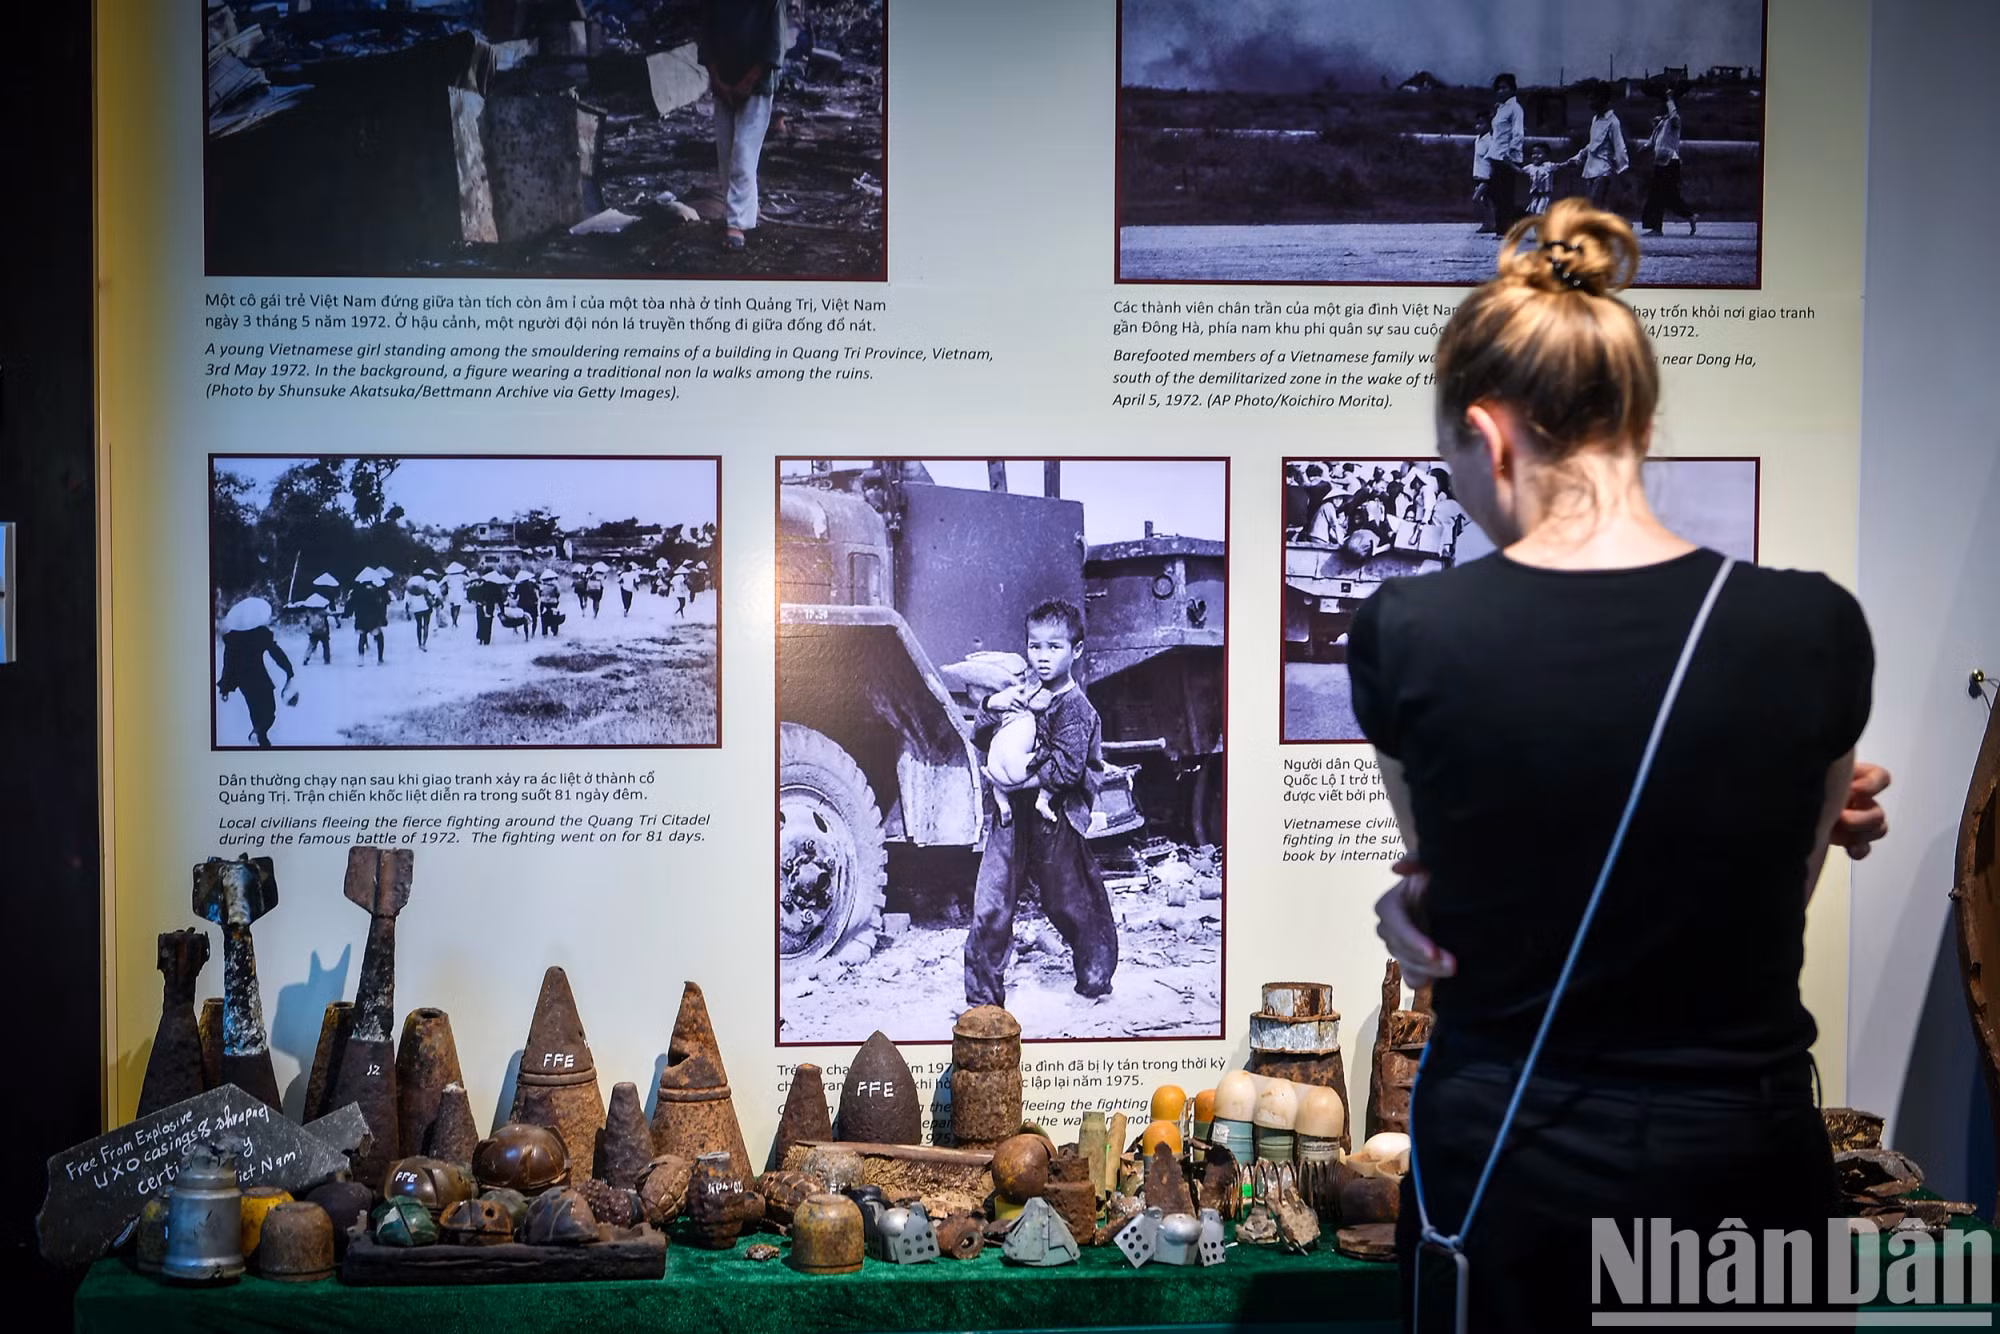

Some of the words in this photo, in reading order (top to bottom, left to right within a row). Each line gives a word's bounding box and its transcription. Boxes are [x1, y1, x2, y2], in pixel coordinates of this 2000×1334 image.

[1633, 305, 1656, 320] hạy
[1660, 304, 1687, 317] trốn
[1692, 305, 1719, 318] khỏi
[1724, 306, 1744, 318] nơi
[1749, 307, 1776, 320] giao
[1780, 306, 1814, 318] tranh
[205, 343, 215, 355] A
[220, 346, 264, 358] young
[270, 343, 353, 356] Vietnamese
[357, 343, 380, 359] girl
[384, 344, 446, 359] standing
[450, 348, 500, 359] among
[505, 344, 527, 356] the
[532, 344, 619, 360] smouldering
[624, 346, 680, 358] remains
[684, 346, 700, 360] of
[702, 349, 711, 358] a
[716, 346, 771, 361] building
[776, 346, 788, 358] in
[793, 347, 839, 361] Quang
[844, 347, 861, 359] Tri
[865, 347, 926, 361] Province,
[933, 348, 992, 362] Vietnam,
[1114, 349, 1190, 364] Barefooted
[1193, 350, 1256, 362] members
[1260, 350, 1275, 365] of
[1278, 353, 1286, 362] a
[1291, 350, 1368, 362] Vietnamese
[1371, 350, 1414, 366] family
[1662, 355, 1693, 365] near
[1696, 354, 1731, 367] Dong
[1735, 354, 1756, 367] Ha,
[205, 363, 230, 376] 3rd
[234, 364, 266, 378] May
[271, 364, 309, 376] 1972.
[316, 364, 328, 376] In
[333, 364, 356, 376] the
[360, 364, 447, 379] background,
[453, 368, 461, 377] a
[464, 364, 507, 380] figure
[512, 366, 569, 380] wearing
[574, 369, 582, 378] a
[588, 365, 661, 378] traditional
[665, 369, 691, 378] non
[696, 366, 708, 378] la
[713, 366, 751, 378] walks
[756, 370, 804, 381] among
[810, 366, 831, 379] the
[836, 368, 872, 379] ruins.
[1113, 372, 1151, 383] south
[1156, 372, 1170, 386] of
[1174, 372, 1194, 384] the
[1199, 372, 1287, 384] demilitarized
[1290, 376, 1321, 384] zone
[1325, 373, 1337, 384] in
[1342, 372, 1363, 384] the
[1368, 373, 1402, 385] wake
[1406, 373, 1421, 388] of
[1424, 373, 1437, 385] th
[206, 383, 253, 399] (Photo
[258, 384, 275, 399] by
[278, 384, 346, 397] Shunsuke
[350, 384, 491, 399] Akatsuka/Bettmann
[496, 385, 548, 398] Archive
[554, 386, 573, 398] via
[578, 386, 616, 401] Getty
[620, 386, 679, 401] Images).
[1112, 394, 1145, 408] April
[1149, 394, 1160, 408] 5,
[1166, 394, 1202, 406] 1972.
[1208, 394, 1231, 408] (AP
[1234, 394, 1334, 408] Photo/Koichiro
[1338, 395, 1392, 409] Morita).
[1284, 758, 1322, 772] Người
[1326, 758, 1350, 769] dân
[220, 774, 246, 786] Dân
[250, 774, 300, 788] thường
[304, 774, 337, 788] chạy
[341, 777, 366, 788] nạn
[370, 777, 394, 785] sau
[399, 774, 418, 785] khi
[422, 774, 451, 788] giao
[456, 774, 492, 784] tranh
[496, 773, 520, 787] xảy
[524, 776, 537, 784] ra
[541, 772, 556, 784] ác
[560, 772, 581, 786] liệt
[584, 772, 592, 784] ở
[596, 772, 635, 784] thành
[640, 770, 654, 784] cổ
[1322, 773, 1336, 788] Lộ
[1350, 773, 1368, 785] trở
[1284, 790, 1315, 803] được
[1347, 789, 1365, 801] bởi
[219, 817, 256, 828] Local
[261, 817, 317, 828] civilians
[322, 816, 369, 830] fleeing
[375, 816, 398, 828] the
[403, 816, 442, 827] fierce
[447, 816, 500, 830] fighting
[505, 816, 555, 826] around
[560, 815, 582, 826] the
[588, 815, 633, 828] Quang
[640, 815, 657, 825] Tri
[662, 814, 710, 825] Citadel
[1284, 819, 1361, 829] Vietnamese
[1283, 834, 1333, 847] fighting
[1338, 834, 1350, 844] in
[1356, 833, 1376, 844] the
[1283, 850, 1315, 861] book
[1320, 850, 1337, 863] by
[543, 1053, 575, 1068] FFE
[1021, 1061, 1032, 1071] ia
[1036, 1060, 1064, 1071] đình
[1068, 1059, 1084, 1071] đã
[1088, 1060, 1099, 1073] bị
[1103, 1060, 1114, 1072] ly
[1118, 1059, 1138, 1070] tán
[1143, 1060, 1178, 1072] trong
[1182, 1057, 1206, 1069] thời
[857, 1081, 894, 1098] FFE
[1032, 1076, 1051, 1089] lập
[1055, 1077, 1069, 1089] lại
[1073, 1075, 1102, 1086] năm
[1106, 1075, 1143, 1086] 1975.
[1022, 1100, 1065, 1113] fleeing
[1071, 1099, 1092, 1110] the
[1097, 1098, 1148, 1112] fighting
[1036, 1115, 1058, 1126] the
[66, 1157, 98, 1180] Free
[100, 1142, 133, 1164] From
[135, 1111, 193, 1145] Explosive
[236, 1164, 256, 1182] iet
